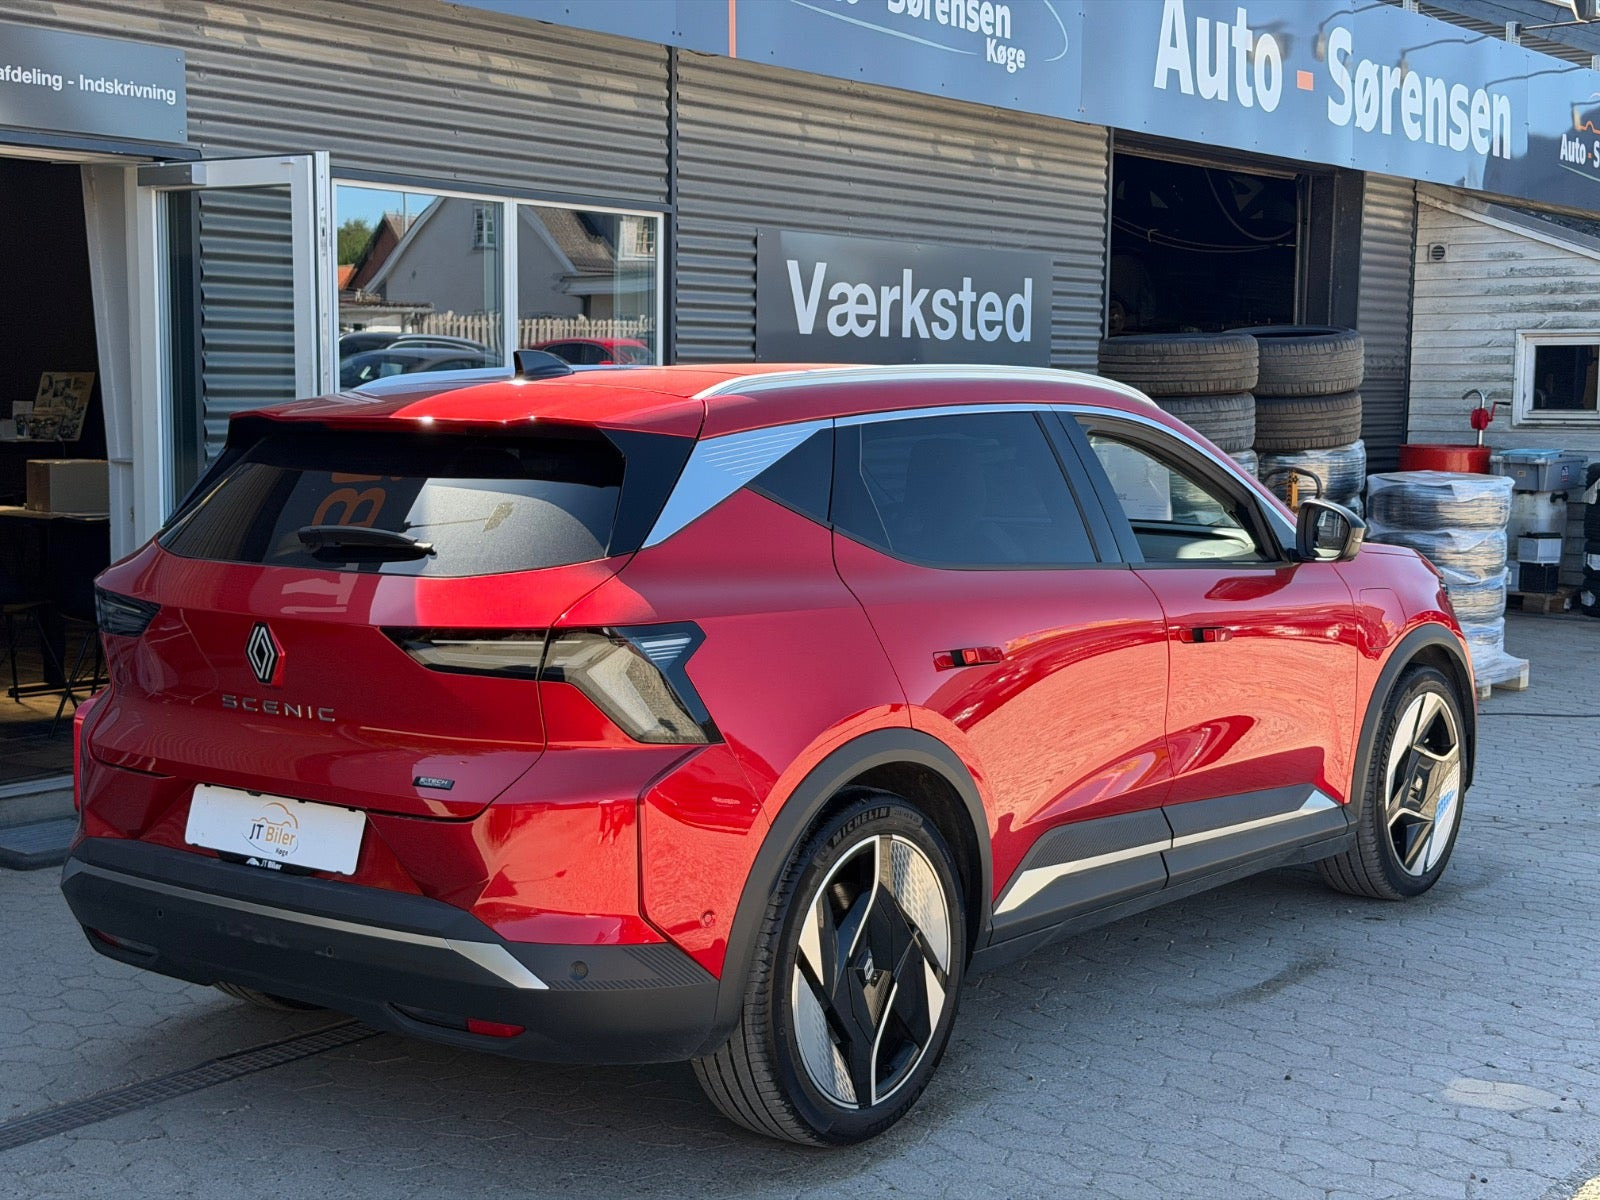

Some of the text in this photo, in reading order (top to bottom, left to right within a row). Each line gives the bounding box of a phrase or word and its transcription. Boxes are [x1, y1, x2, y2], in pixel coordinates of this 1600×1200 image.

[986, 38, 1026, 73] Køge
[79, 74, 176, 105] Indskrivning
[1153, 0, 1282, 112] Auto
[1328, 26, 1511, 159] Sørensen
[1560, 133, 1586, 165] Auto
[787, 260, 1032, 343] Værksted
[221, 694, 336, 722] SCENIC
[249, 823, 296, 846] JT Biler
[832, 806, 889, 847] MICHELIN
